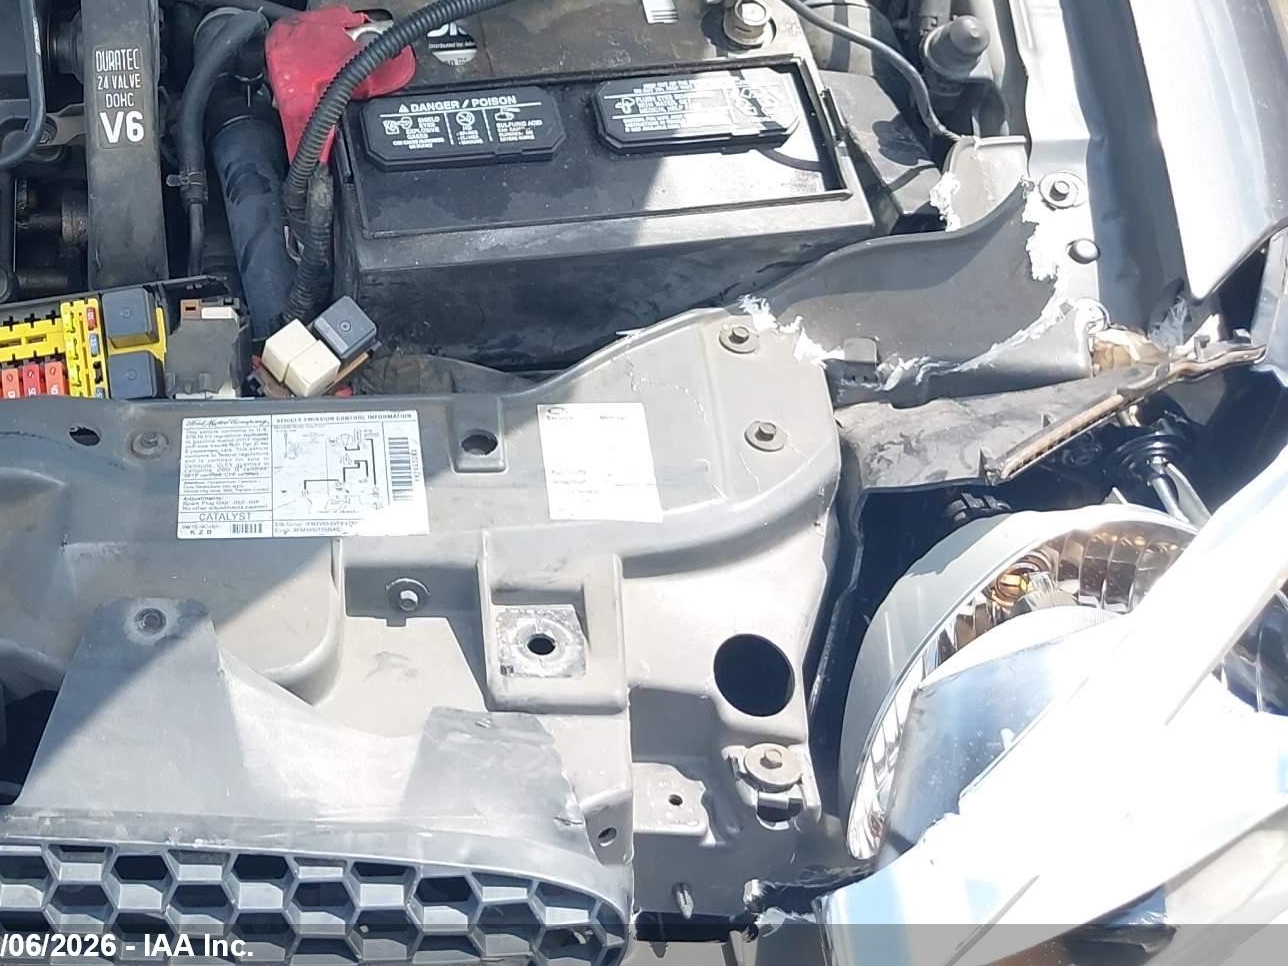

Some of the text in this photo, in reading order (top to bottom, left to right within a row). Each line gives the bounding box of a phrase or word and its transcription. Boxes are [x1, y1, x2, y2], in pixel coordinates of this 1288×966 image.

[95, 48, 140, 72] DURATEC
[97, 73, 141, 90] 24 VALVE
[106, 92, 134, 108] DOHC
[410, 100, 459, 113] DANGER
[472, 95, 517, 107] POISON
[99, 110, 144, 143] V6
[199, 512, 251, 521] CATALYST
